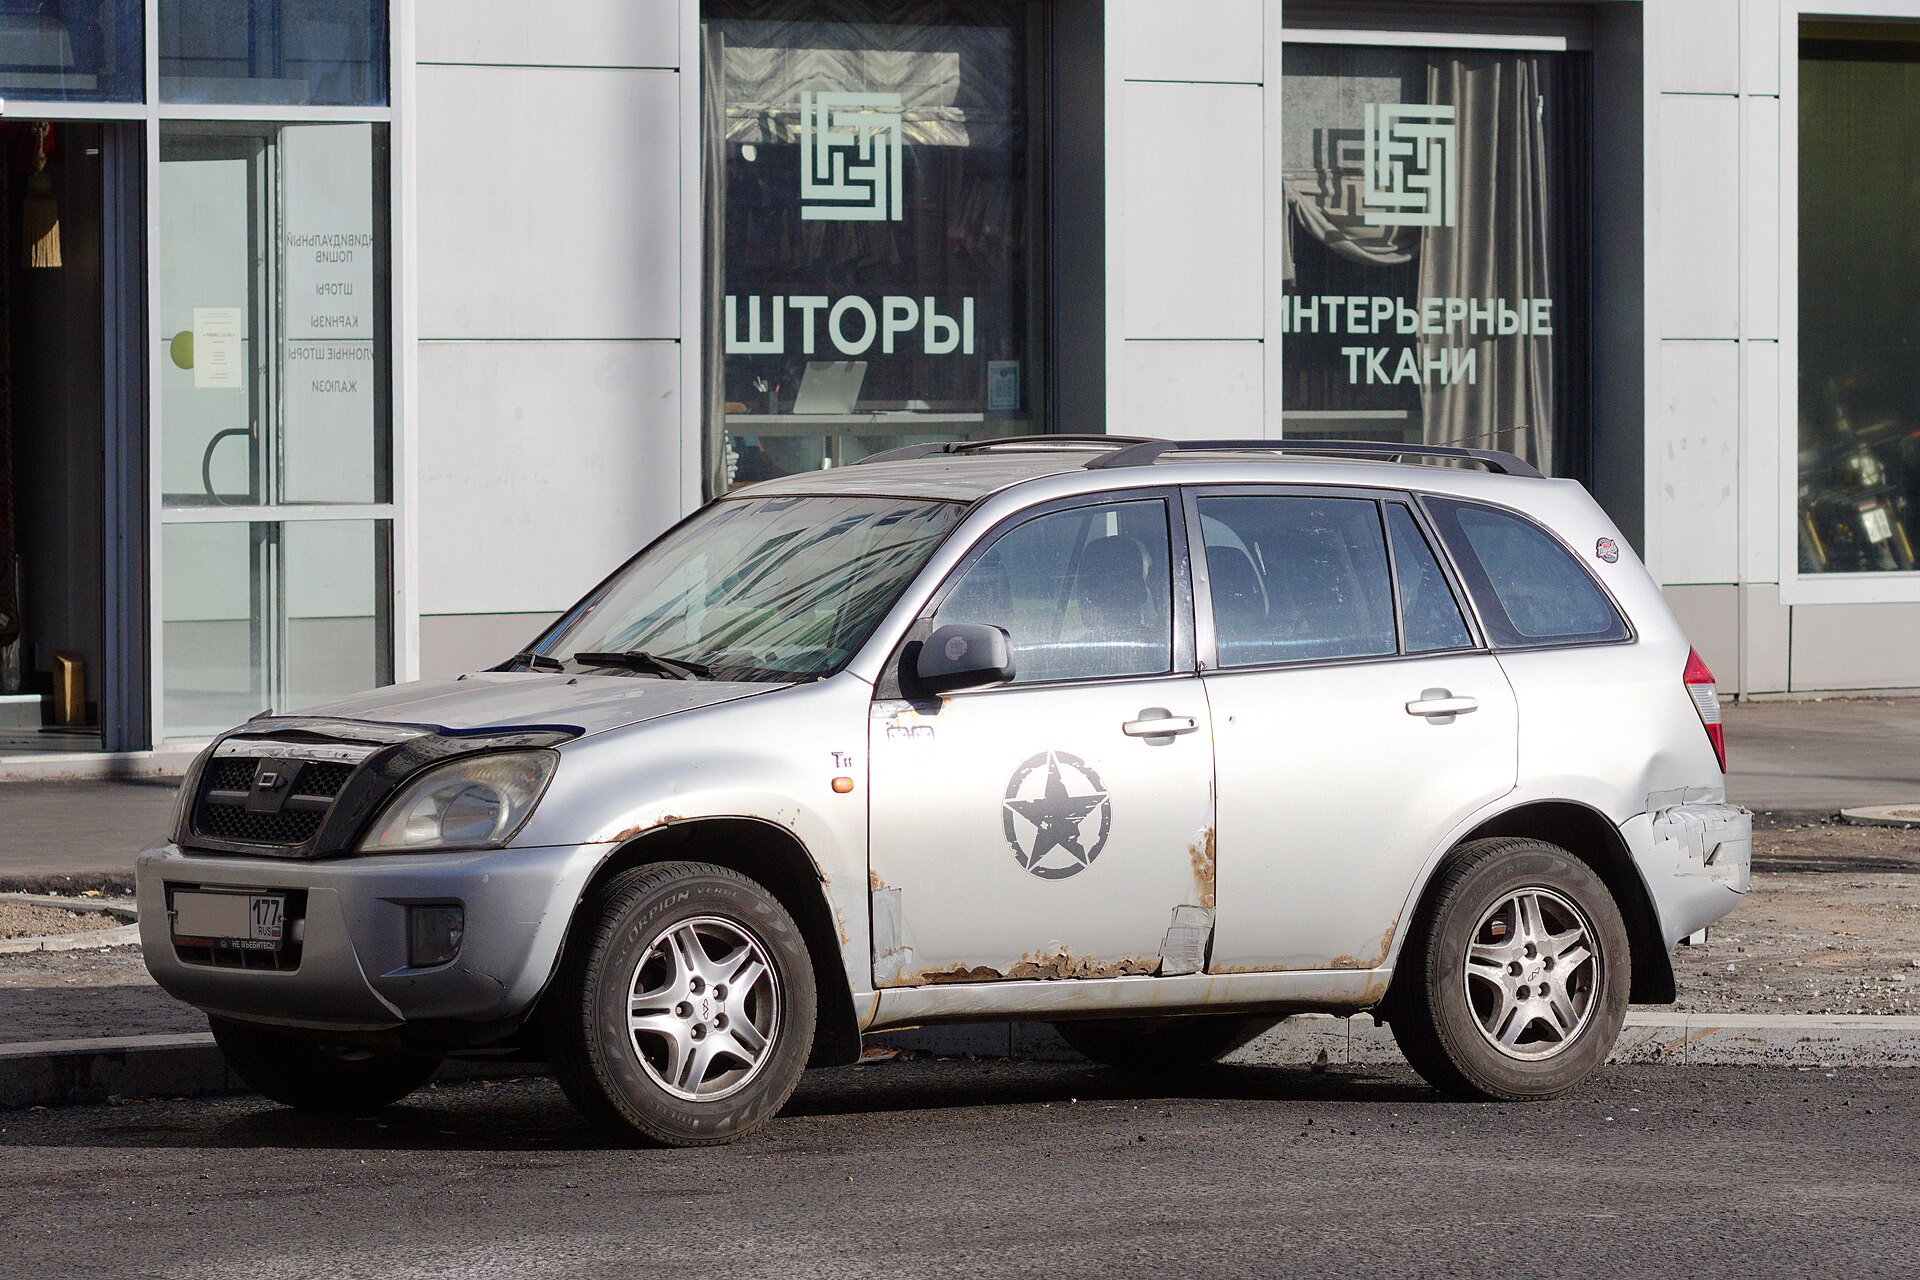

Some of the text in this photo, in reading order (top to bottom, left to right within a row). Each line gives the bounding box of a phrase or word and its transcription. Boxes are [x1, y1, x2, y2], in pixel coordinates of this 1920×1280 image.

[725, 295, 974, 355] ШТОРЫ
[1341, 347, 1476, 385] ТКАНИ
[252, 898, 280, 925] 177
[258, 926, 272, 936] RUS
